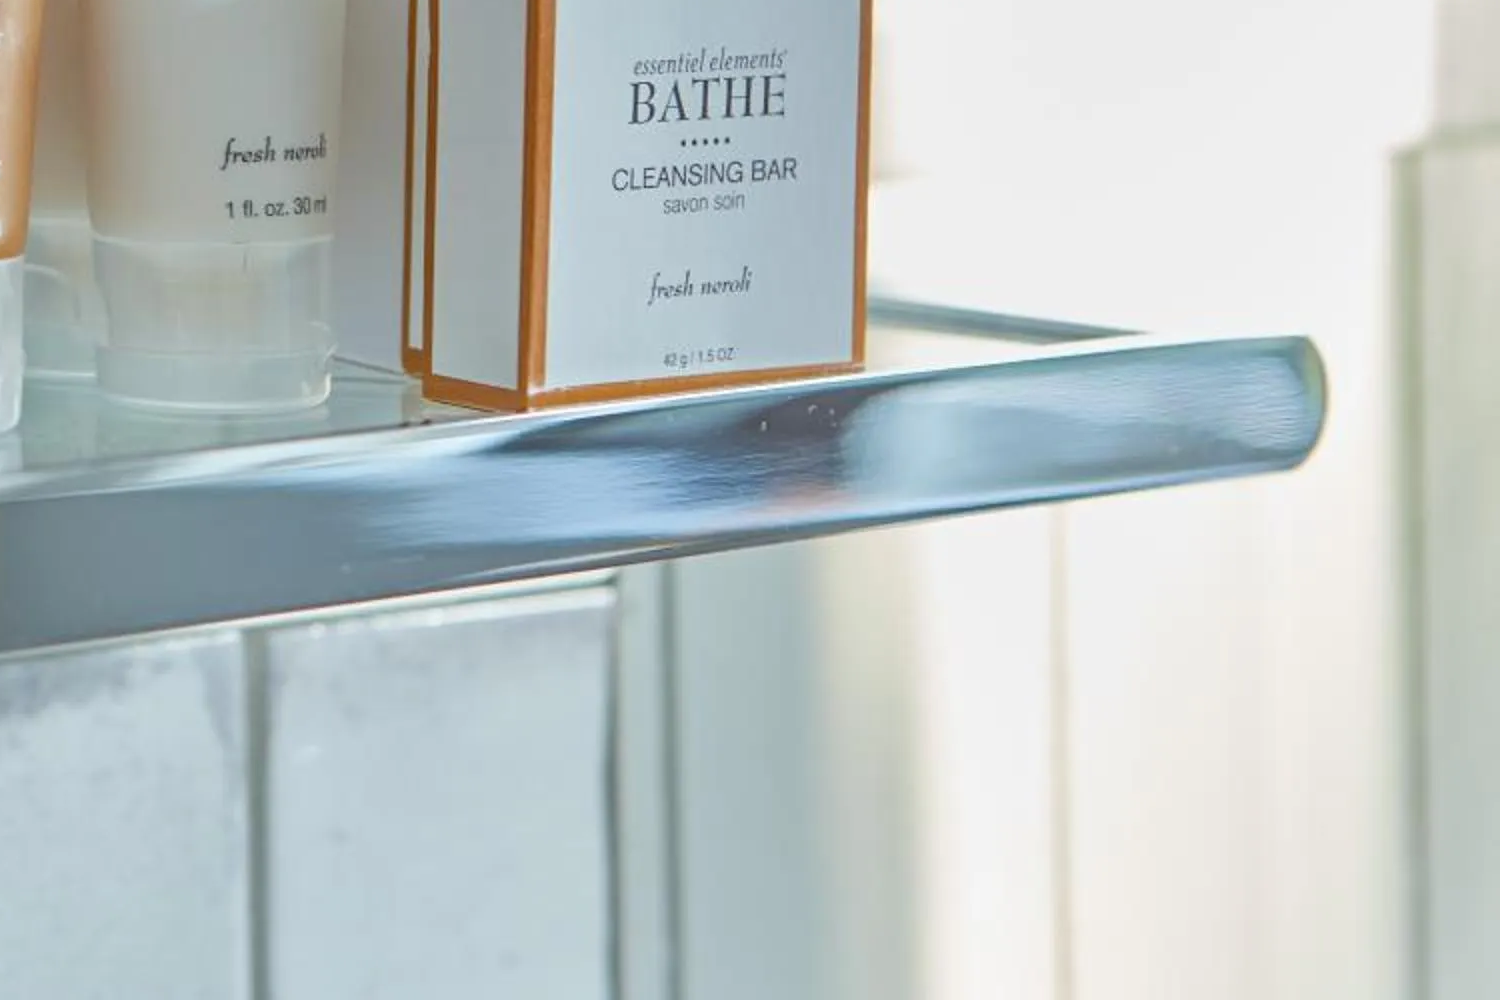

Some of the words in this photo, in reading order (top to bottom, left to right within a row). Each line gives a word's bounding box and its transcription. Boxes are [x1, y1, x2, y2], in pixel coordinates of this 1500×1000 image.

[633, 47, 706, 77] essentiel
[709, 46, 785, 73] elements
[628, 73, 787, 125] BATHE
[219, 135, 276, 171] fresh
[283, 132, 327, 162] neroli
[612, 161, 744, 192] CLEANSING
[751, 157, 798, 182] BAR
[225, 201, 234, 219] 1
[264, 202, 289, 217] oz.
[293, 196, 311, 215] 30
[663, 196, 709, 216] savon
[713, 190, 746, 212] soin
[647, 269, 694, 307] fresh
[700, 265, 753, 295] neroli
